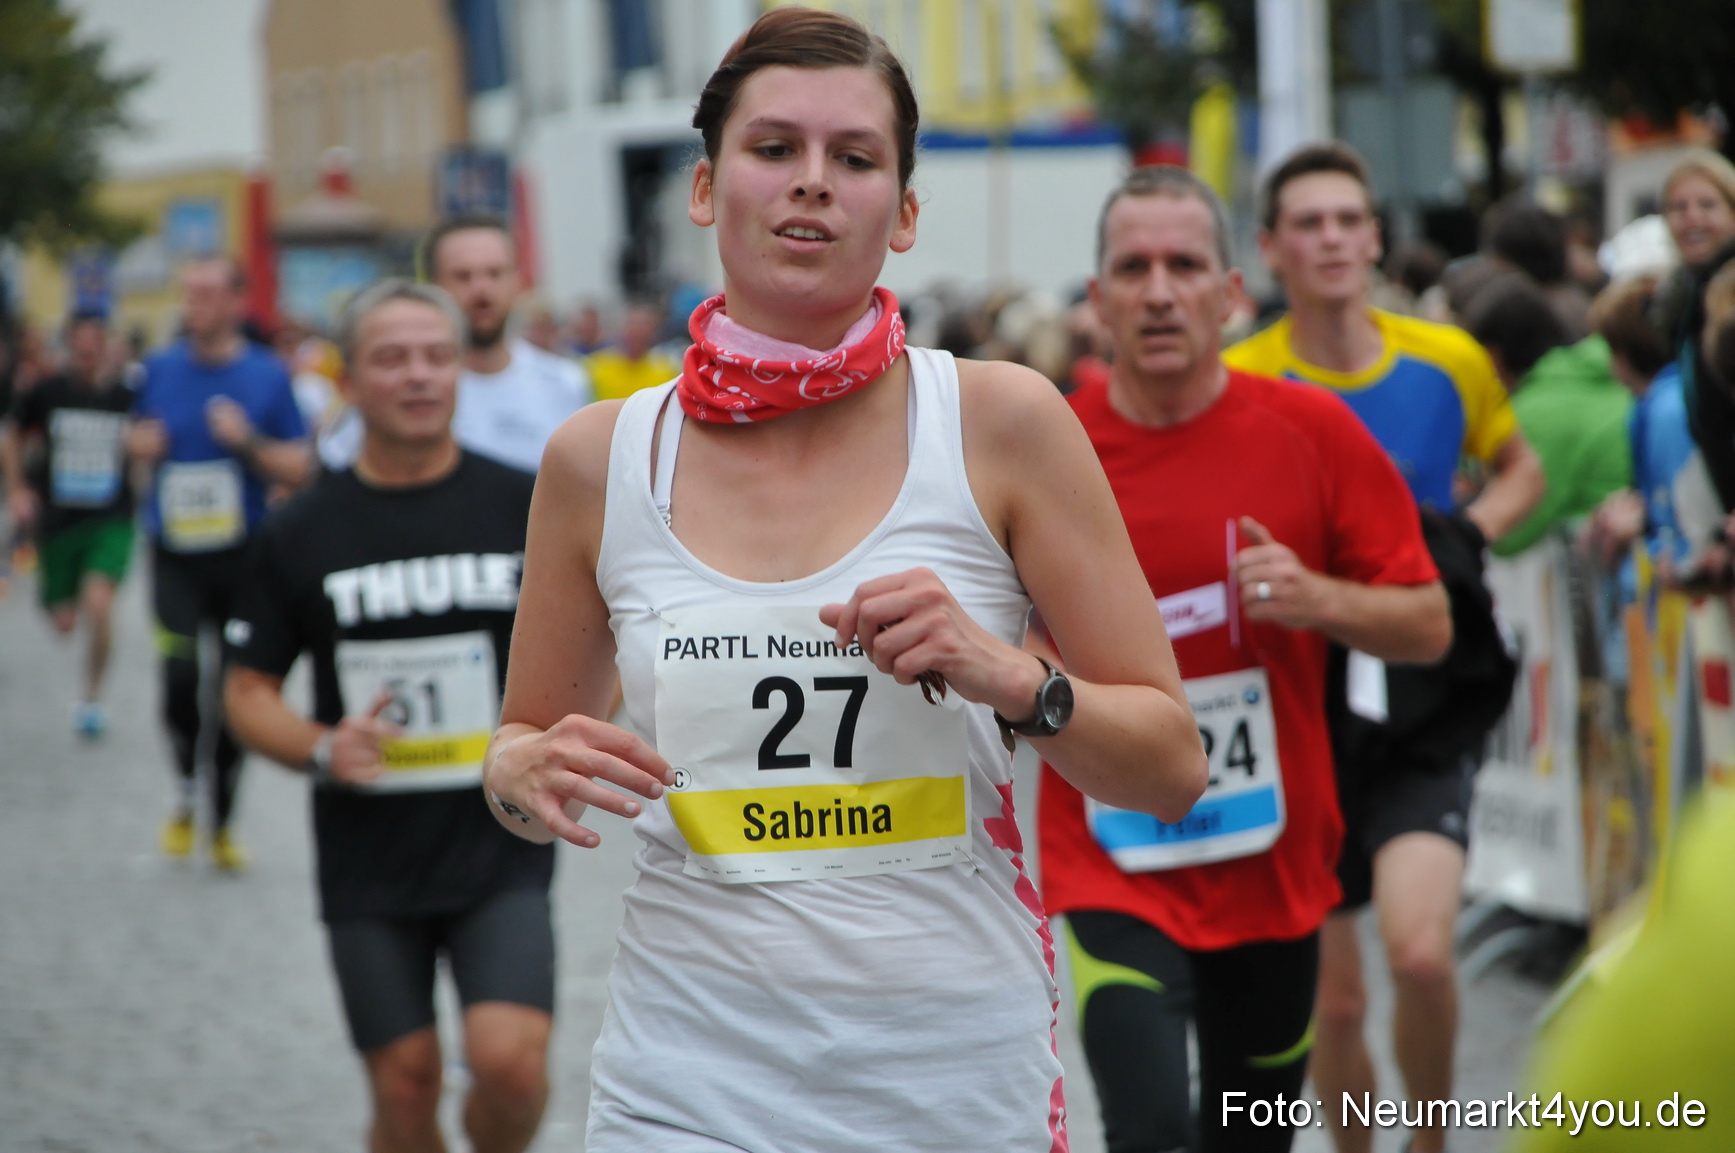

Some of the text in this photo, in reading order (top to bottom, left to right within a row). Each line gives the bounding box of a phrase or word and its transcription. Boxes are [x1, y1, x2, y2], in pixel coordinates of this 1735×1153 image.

[324, 553, 521, 628] THULE
[663, 634, 864, 660] PARTL Neuma
[751, 675, 869, 771] 27
[742, 798, 892, 842] Sabrina
